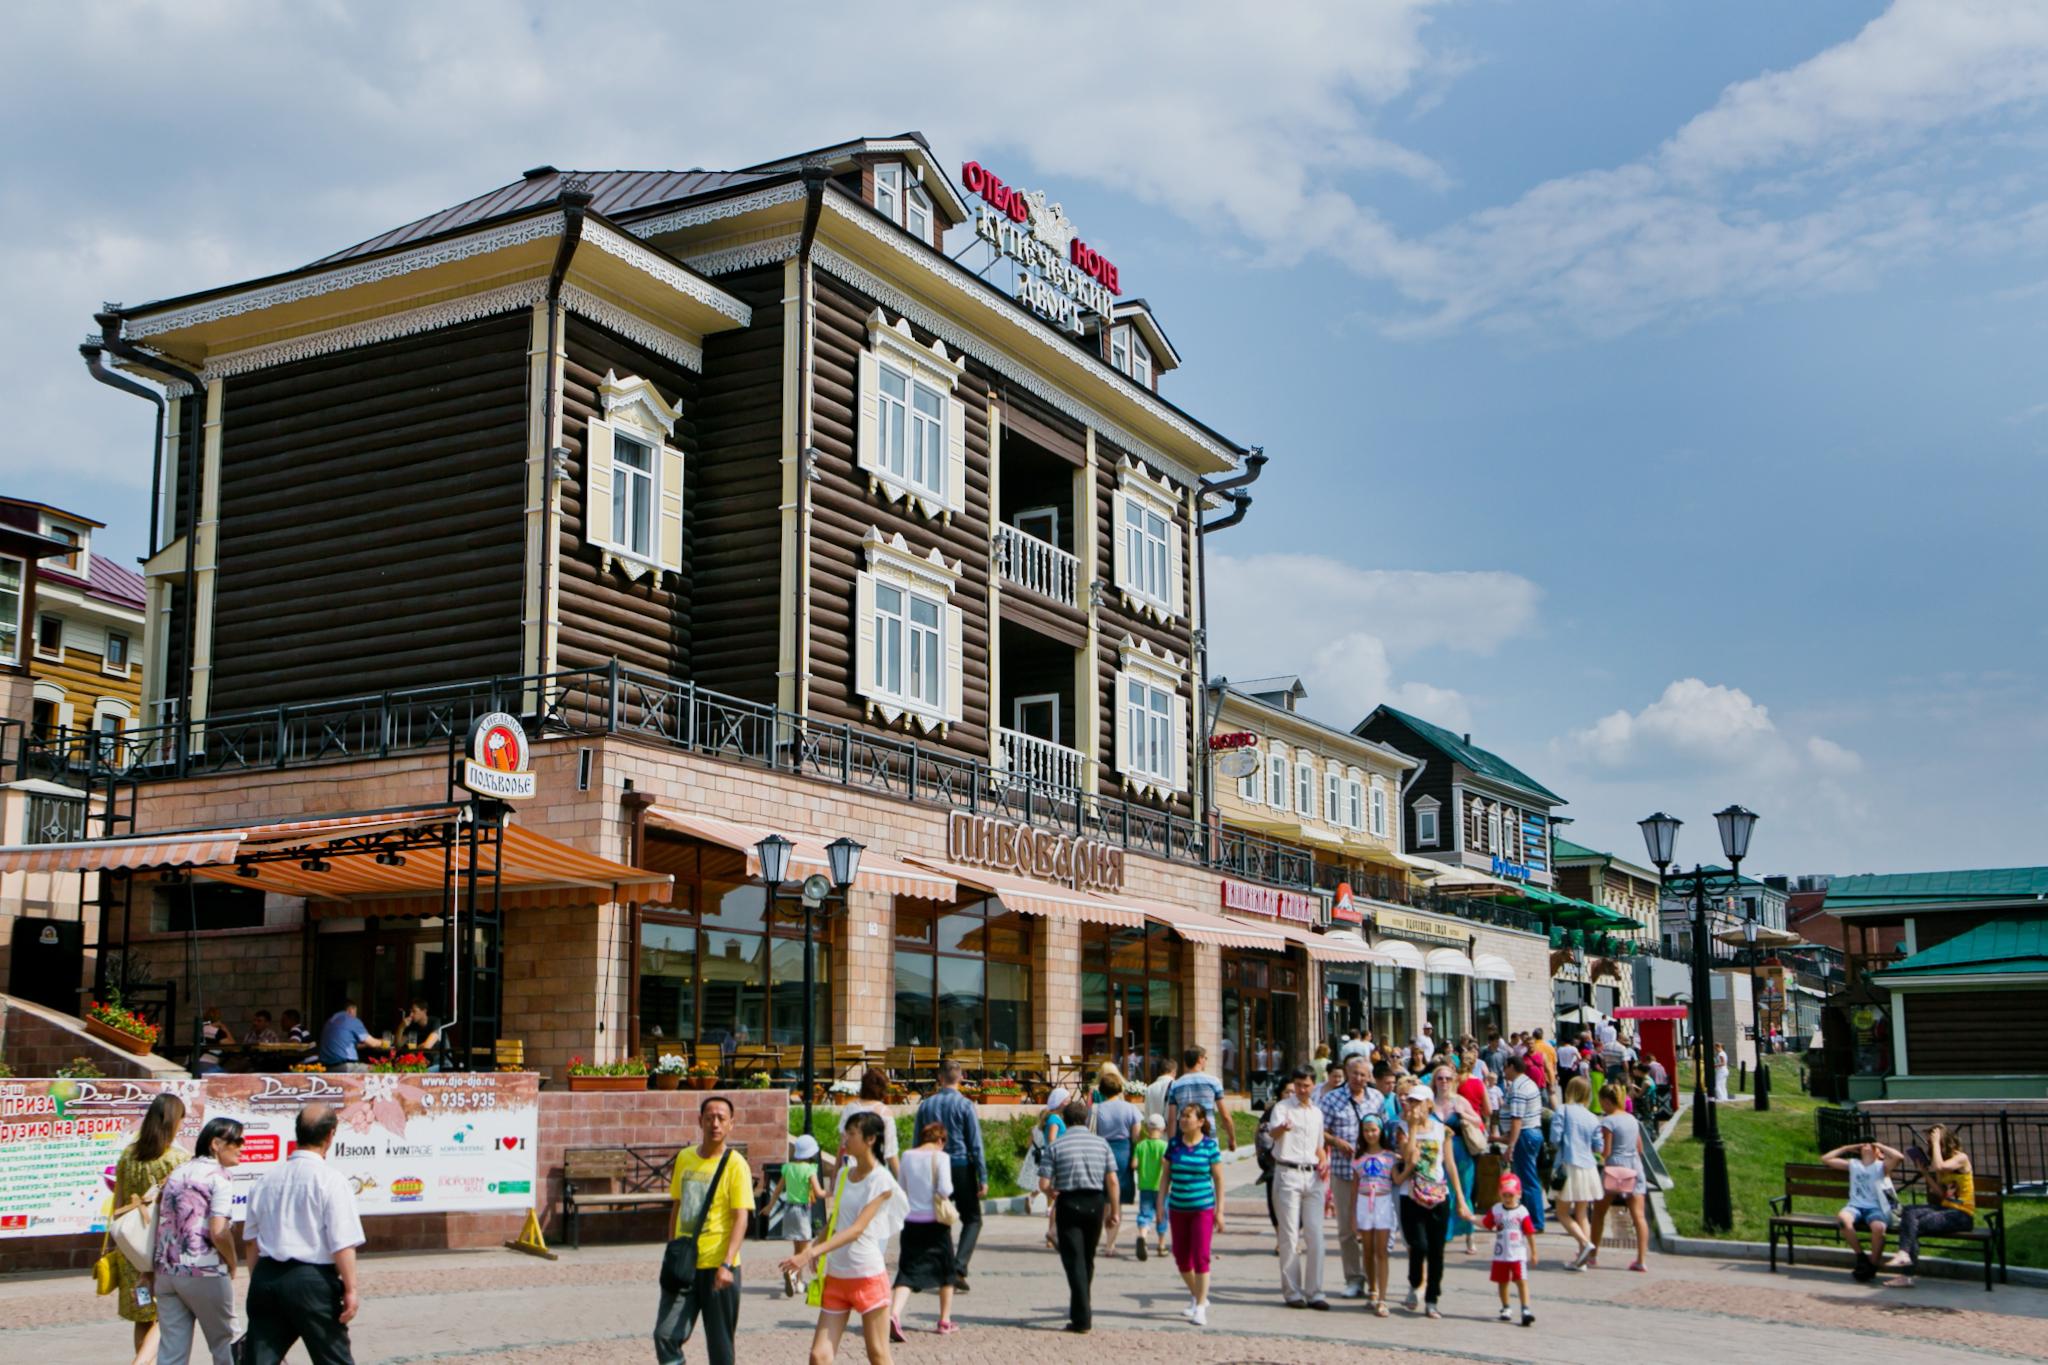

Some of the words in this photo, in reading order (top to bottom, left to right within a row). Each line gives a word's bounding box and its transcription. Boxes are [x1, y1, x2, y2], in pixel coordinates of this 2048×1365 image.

[963, 161, 1028, 224] ОТЕЛЬ
[975, 205, 1116, 324] КУПЕЧЕСКИЙ
[1071, 237, 1122, 296] HOTEL
[250, 1076, 343, 1101] Джо-Джо
[421, 1075, 496, 1089] www.djo-djo.ru
[4, 1095, 57, 1114] ПРИЗА
[440, 1093, 496, 1108] 935-935
[0, 1121, 50, 1142] рузию
[54, 1120, 73, 1135] на
[335, 1142, 376, 1157] Изюм
[392, 1144, 433, 1156] VINTAGE
